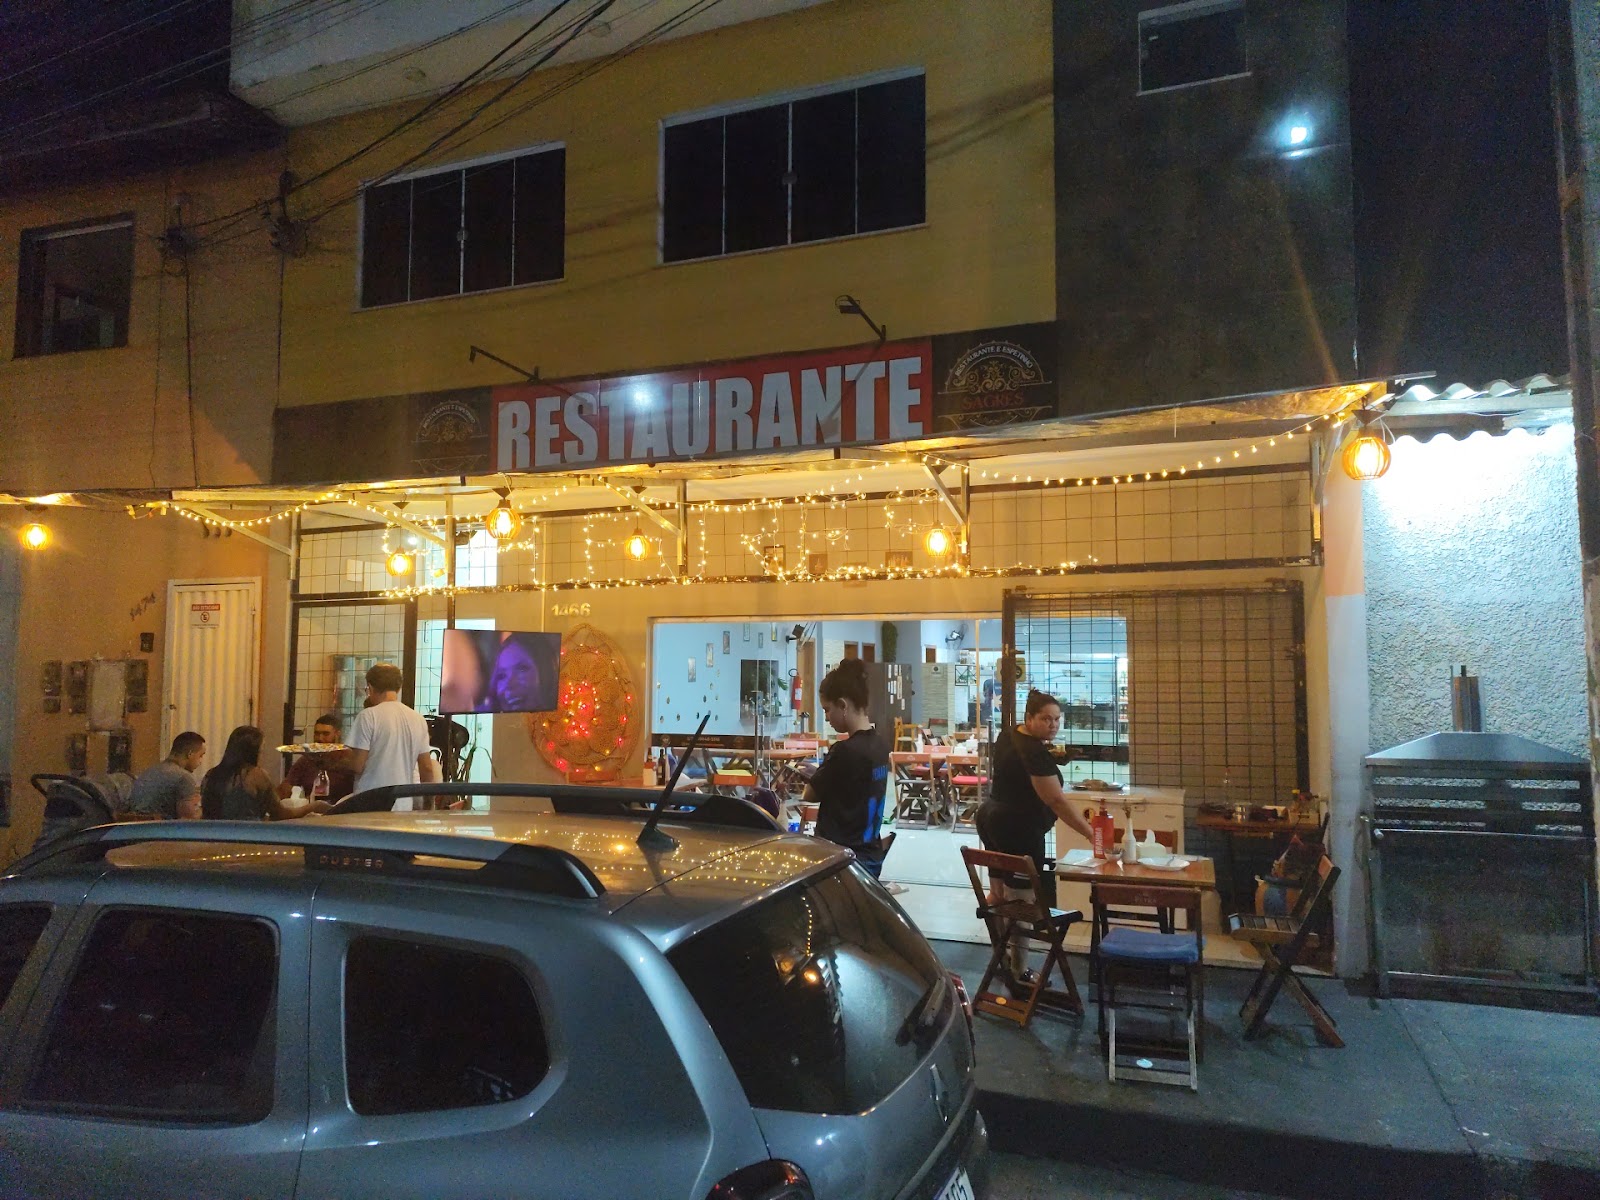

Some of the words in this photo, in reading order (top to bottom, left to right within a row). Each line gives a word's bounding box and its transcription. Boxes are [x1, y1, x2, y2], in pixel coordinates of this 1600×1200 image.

[955, 347, 995, 377] RESTAURANTE
[497, 356, 924, 472] RESTAURANTE
[551, 602, 591, 616] 1466
[319, 855, 384, 869] DUSTER
